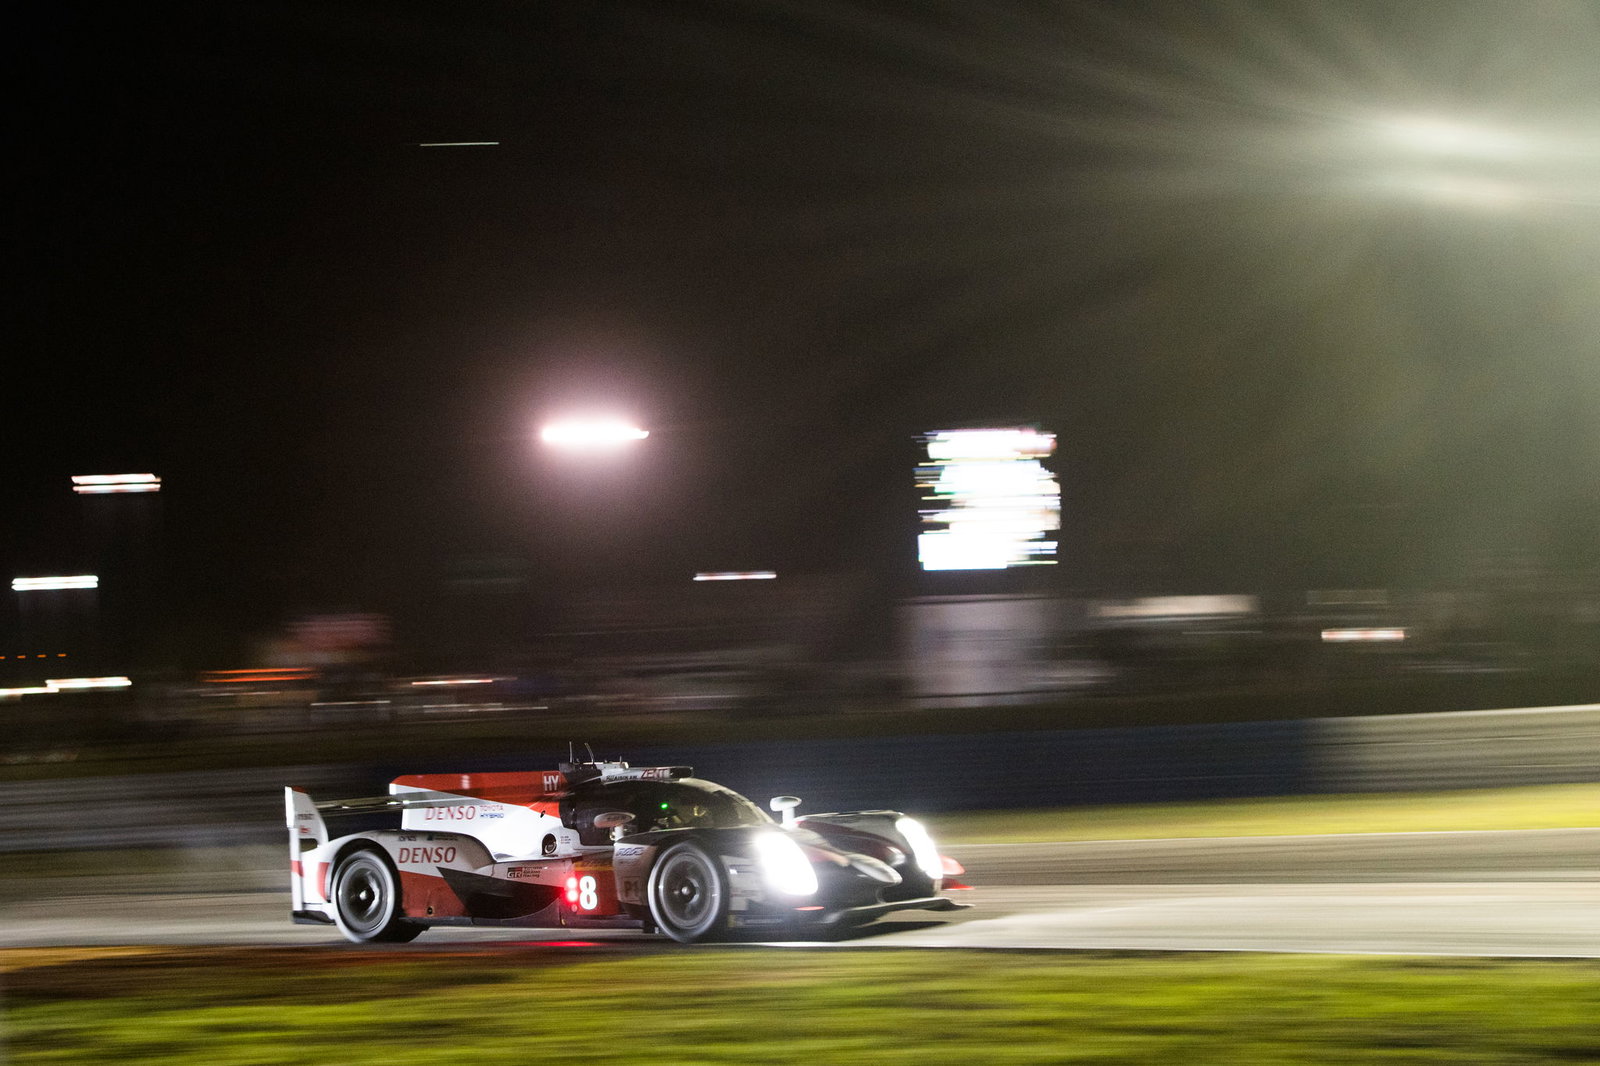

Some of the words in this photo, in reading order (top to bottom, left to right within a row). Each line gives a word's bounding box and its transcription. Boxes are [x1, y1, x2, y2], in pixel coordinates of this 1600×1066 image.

[543, 775, 559, 791] HY
[425, 805, 476, 820] DENSO
[398, 846, 456, 864] DENSO
[579, 875, 598, 911] 8
